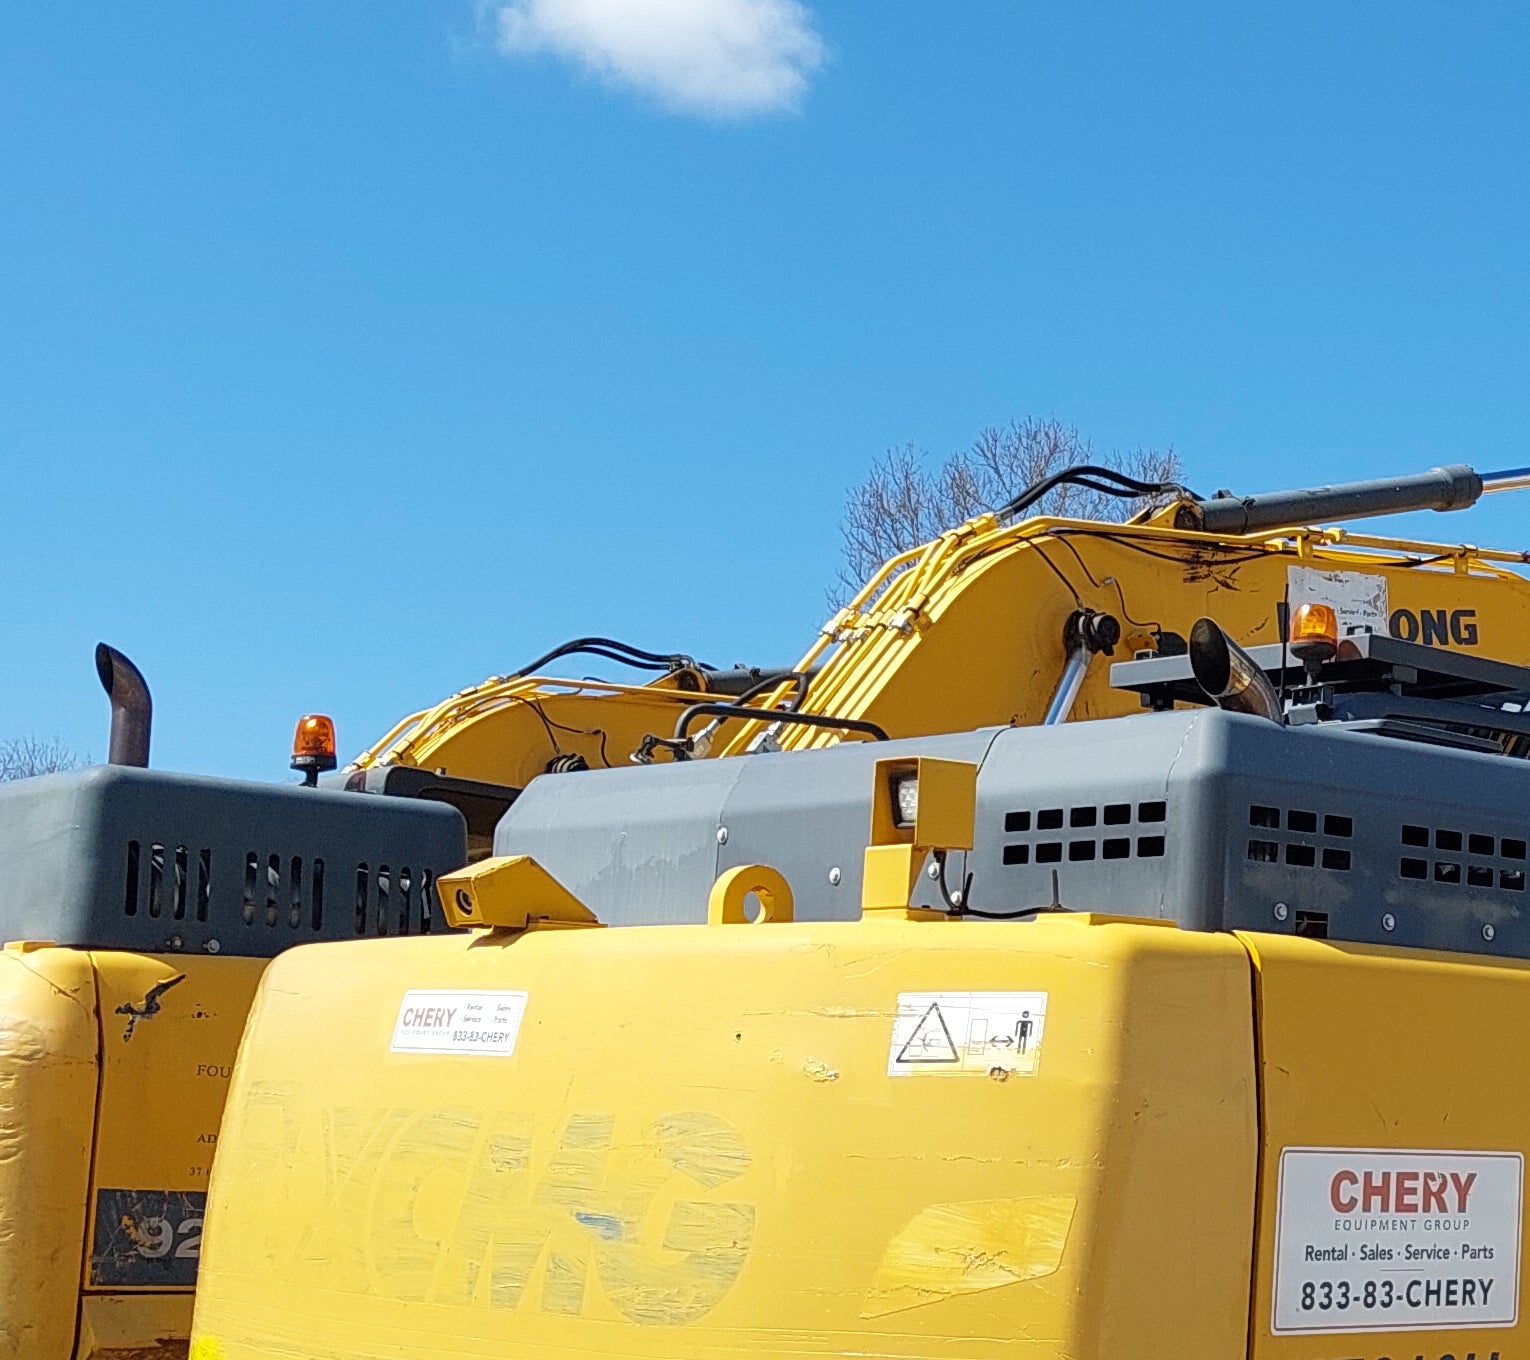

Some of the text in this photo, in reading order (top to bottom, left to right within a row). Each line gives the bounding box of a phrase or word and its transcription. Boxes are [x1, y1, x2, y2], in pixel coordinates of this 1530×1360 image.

[1389, 608, 1479, 646] ONG
[402, 1007, 458, 1028] CHERY
[197, 1064, 232, 1078] FOU
[197, 1134, 218, 1144] AD
[1330, 1170, 1478, 1214] CHERY
[1334, 1219, 1471, 1232] EQUIPMENT GROUP
[137, 1217, 204, 1259] 92
[1305, 1243, 1495, 1262] Rental Sales Service Parts
[1301, 1278, 1495, 1310] 833-83-CHERY
